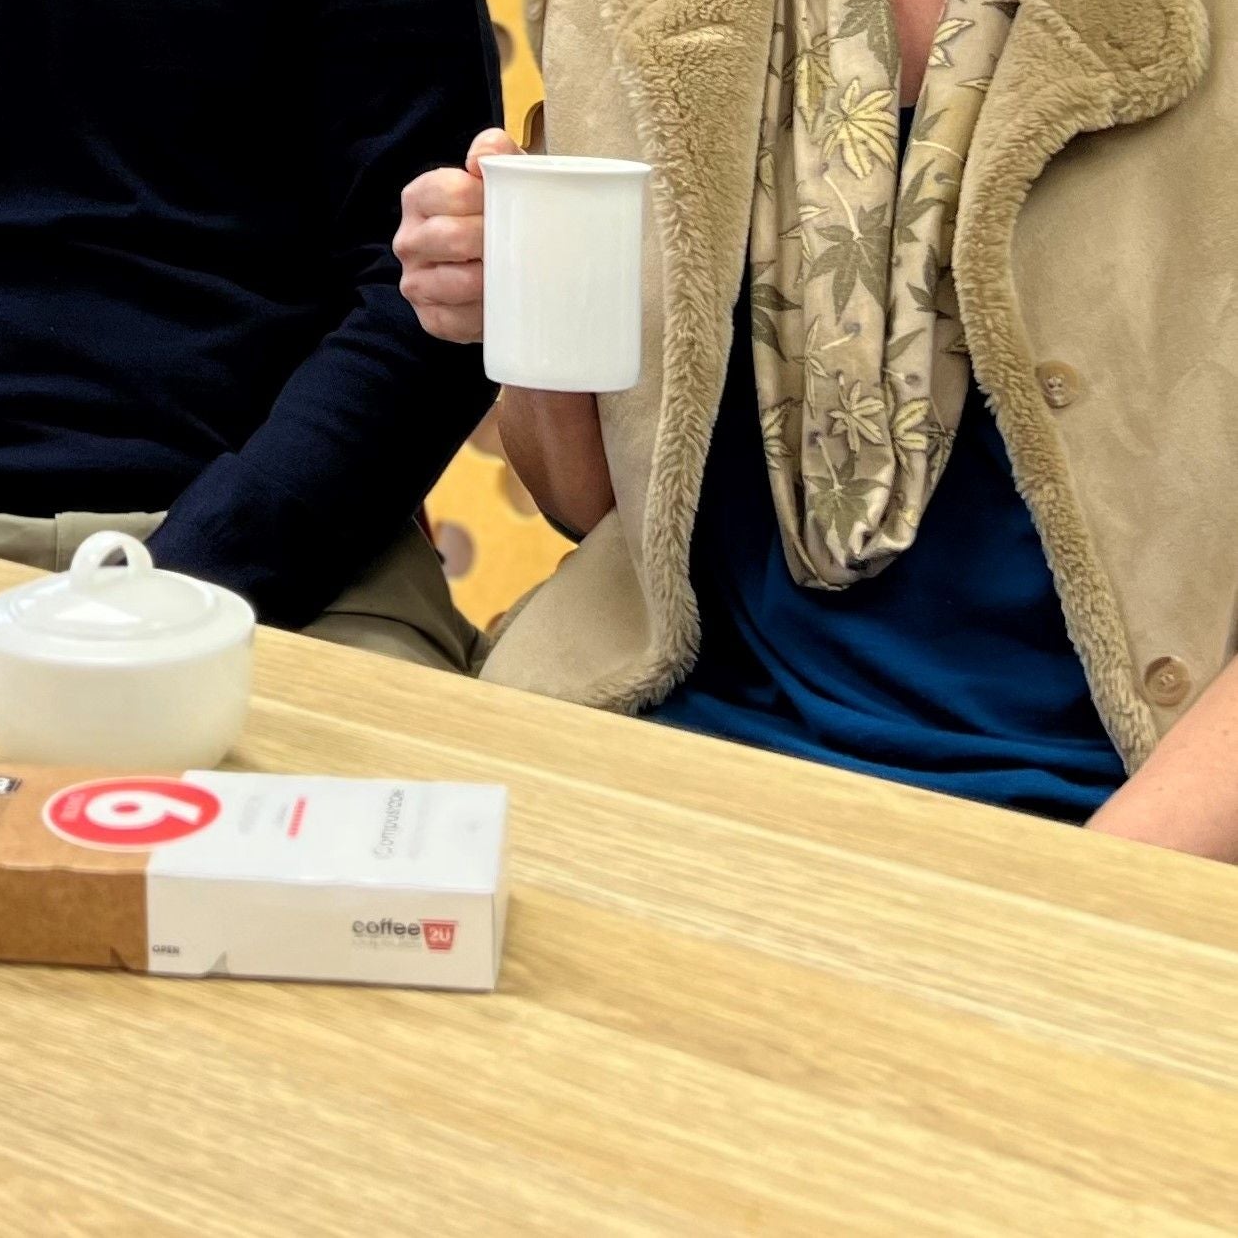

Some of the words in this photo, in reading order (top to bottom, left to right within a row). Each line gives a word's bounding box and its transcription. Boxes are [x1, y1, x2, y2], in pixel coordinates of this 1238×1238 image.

[351, 918, 421, 938] coffee
[428, 925, 451, 943] 2U
[151, 945, 181, 956] OPEN
